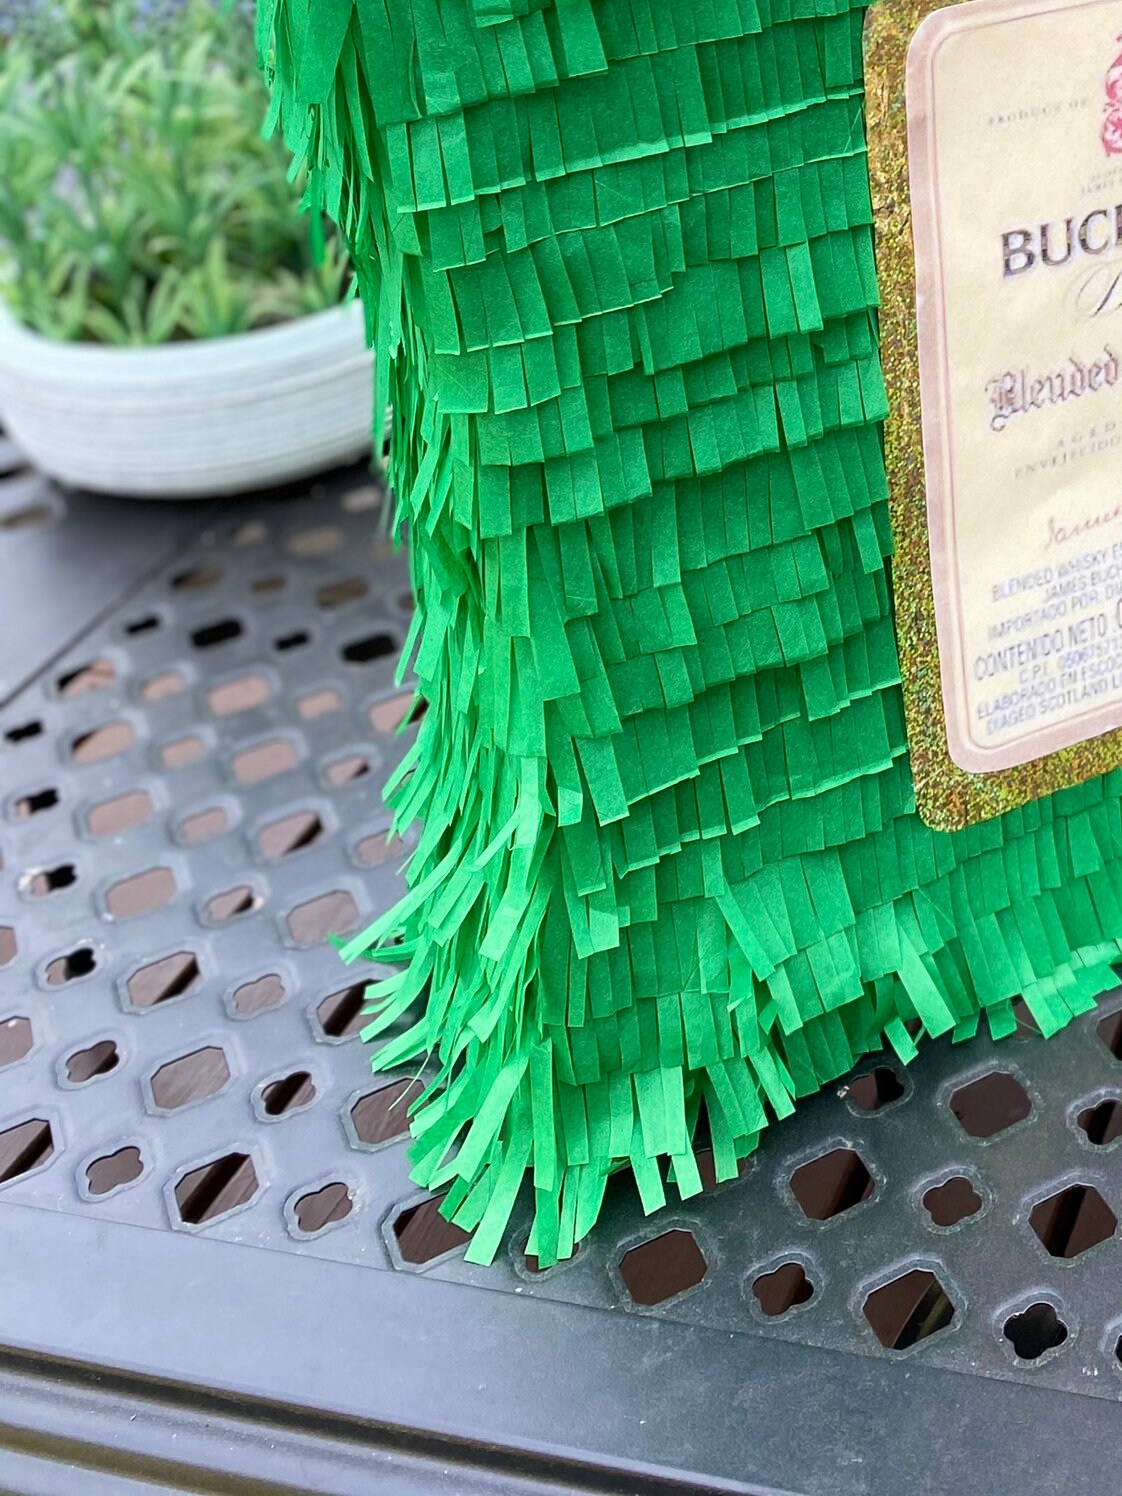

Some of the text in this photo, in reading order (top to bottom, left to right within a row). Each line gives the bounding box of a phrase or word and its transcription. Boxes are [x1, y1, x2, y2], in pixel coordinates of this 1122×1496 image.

[984, 348, 1120, 432] Blended
[992, 568, 1053, 603] BLENDED
[1046, 575, 1087, 603] JAMES
[974, 629, 1064, 681] CONTENIDO
[977, 679, 1056, 720] ELABORADO
[1061, 669, 1077, 690] EN
[1039, 678, 1108, 715] SCOTLAND
